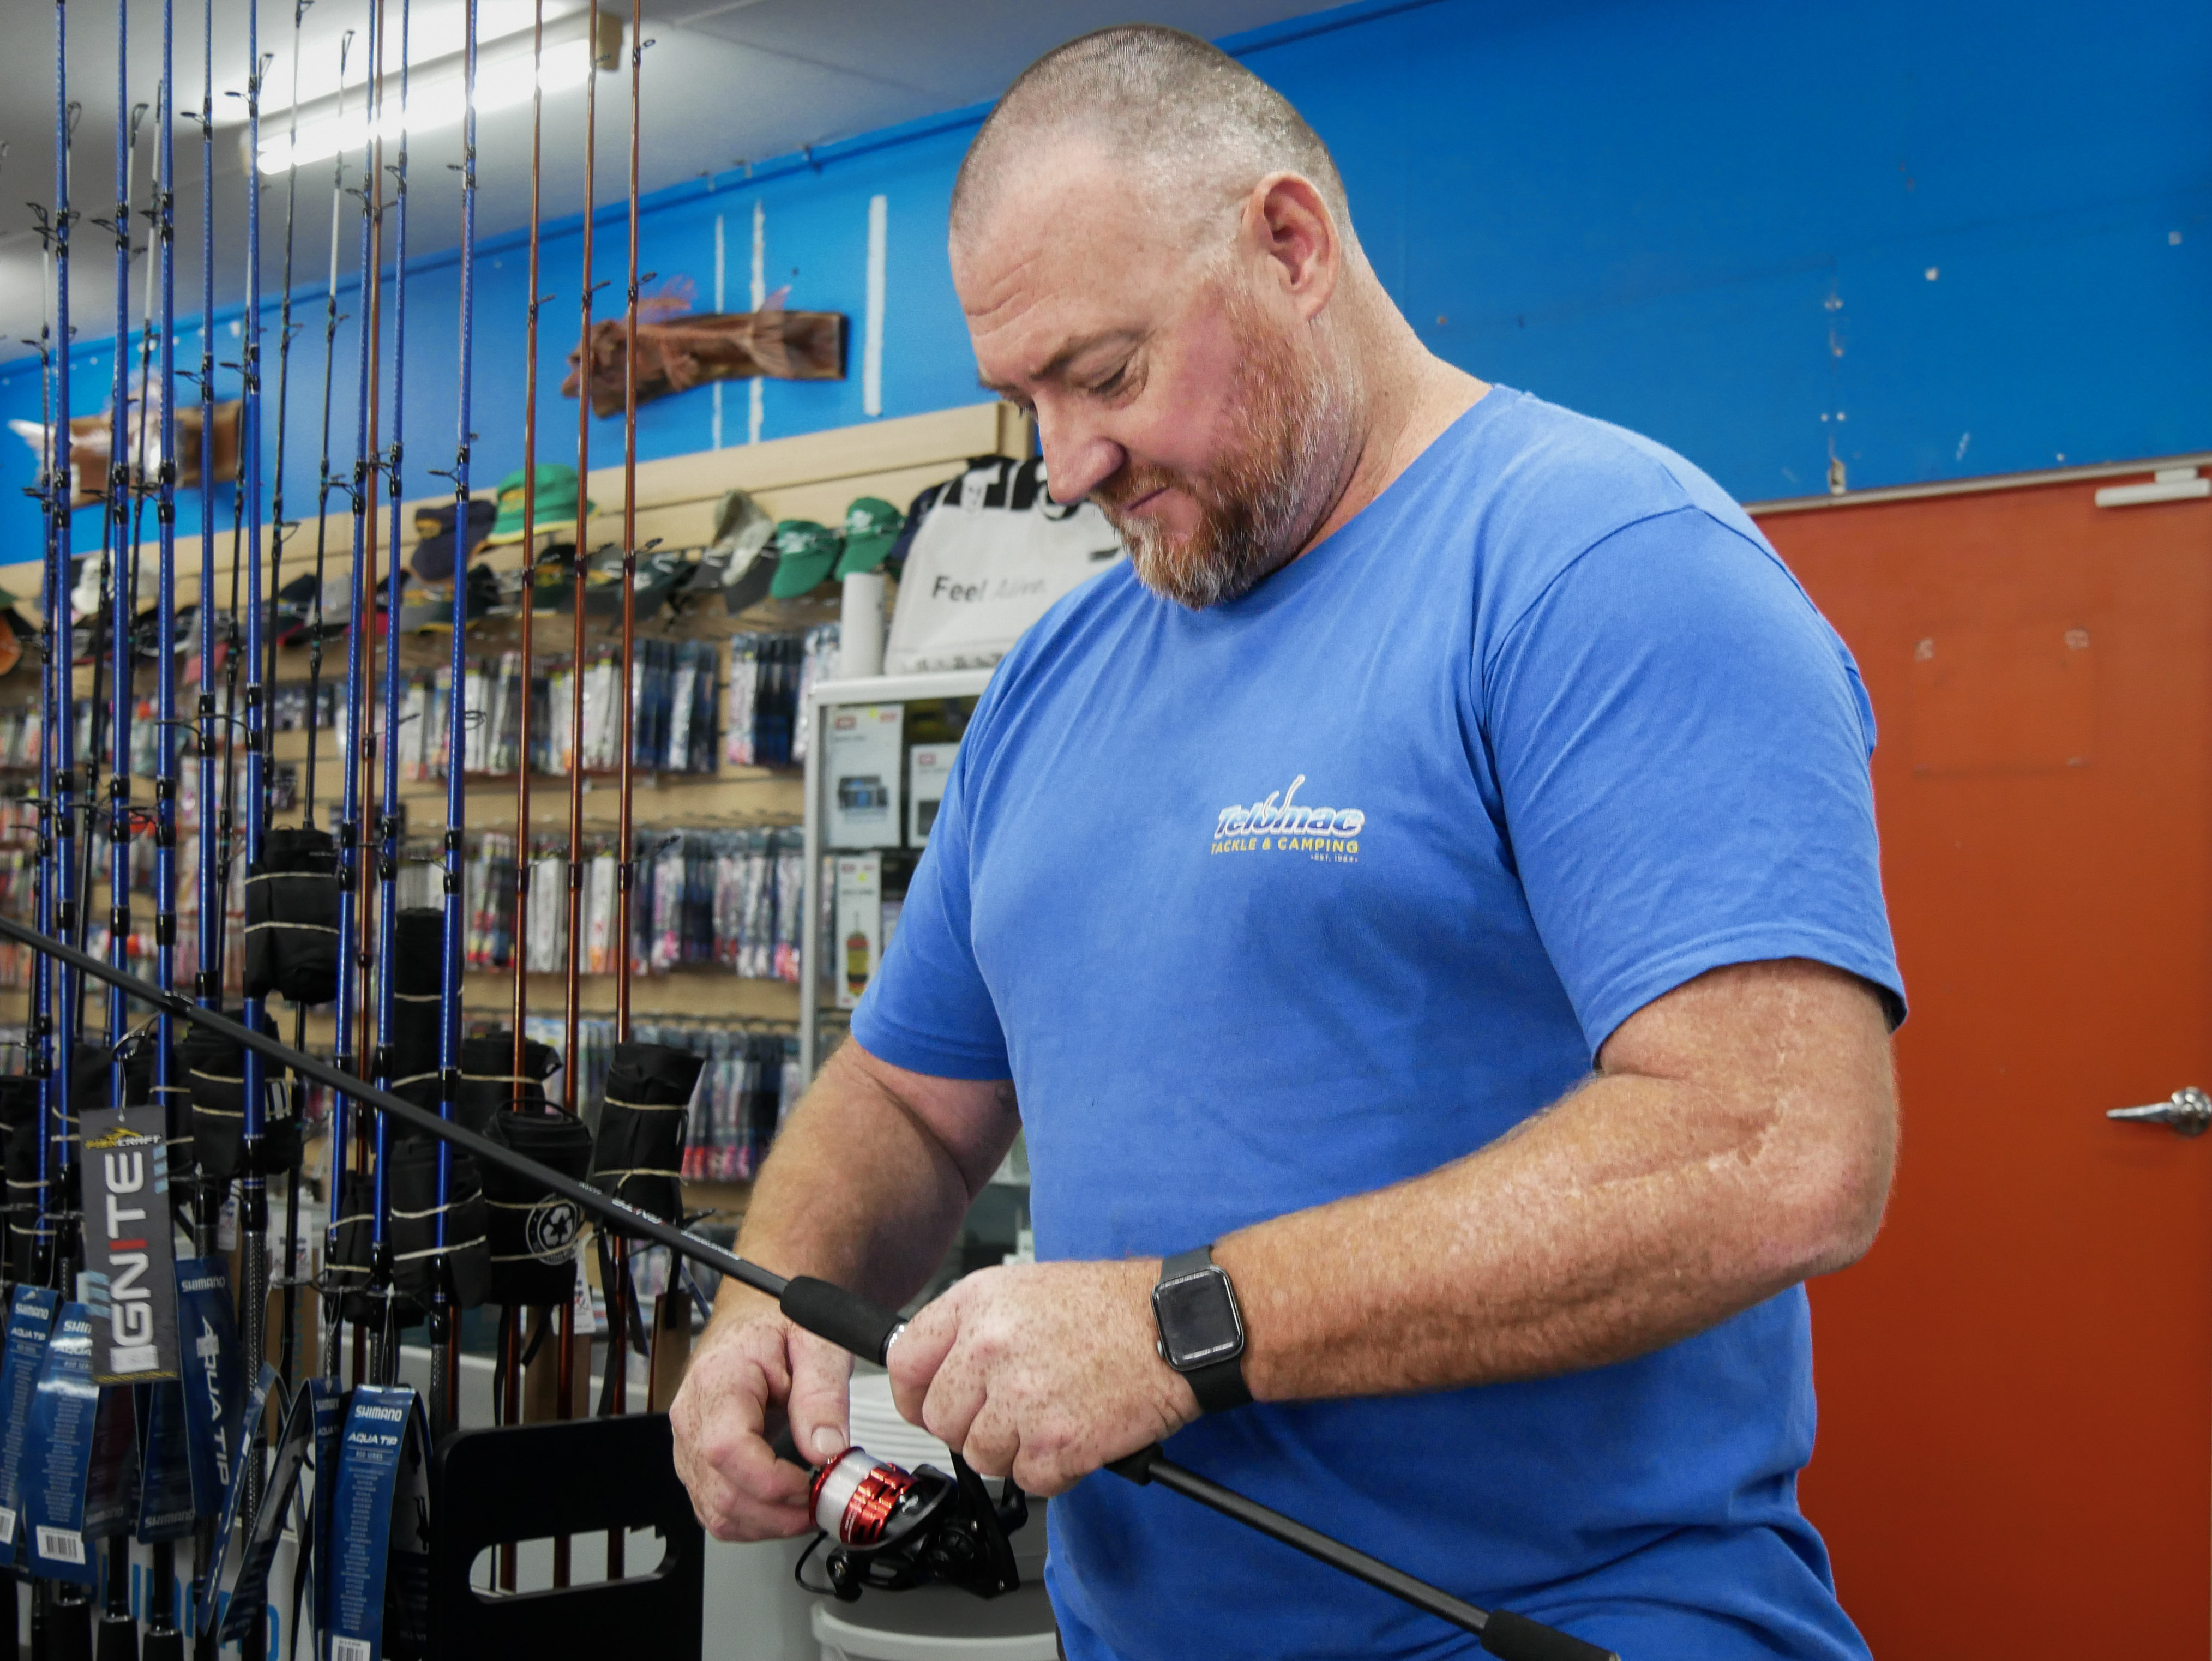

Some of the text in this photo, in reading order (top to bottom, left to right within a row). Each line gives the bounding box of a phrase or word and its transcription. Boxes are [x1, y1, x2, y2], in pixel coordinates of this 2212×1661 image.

[1210, 837, 1359, 855] TACKLE & CAMPING
[105, 1151, 160, 1374] IGNITE
[181, 1275, 226, 1293] SHIMANO
[15, 1302, 49, 1320] SHIMANO
[10, 1326, 47, 1341] AQUA TIP
[354, 1404, 403, 1422] SHIMANO
[347, 1431, 398, 1446] AQUA TIP
[214, 1425, 230, 1486] TIP
[144, 1509, 196, 1529] SHIMANO
